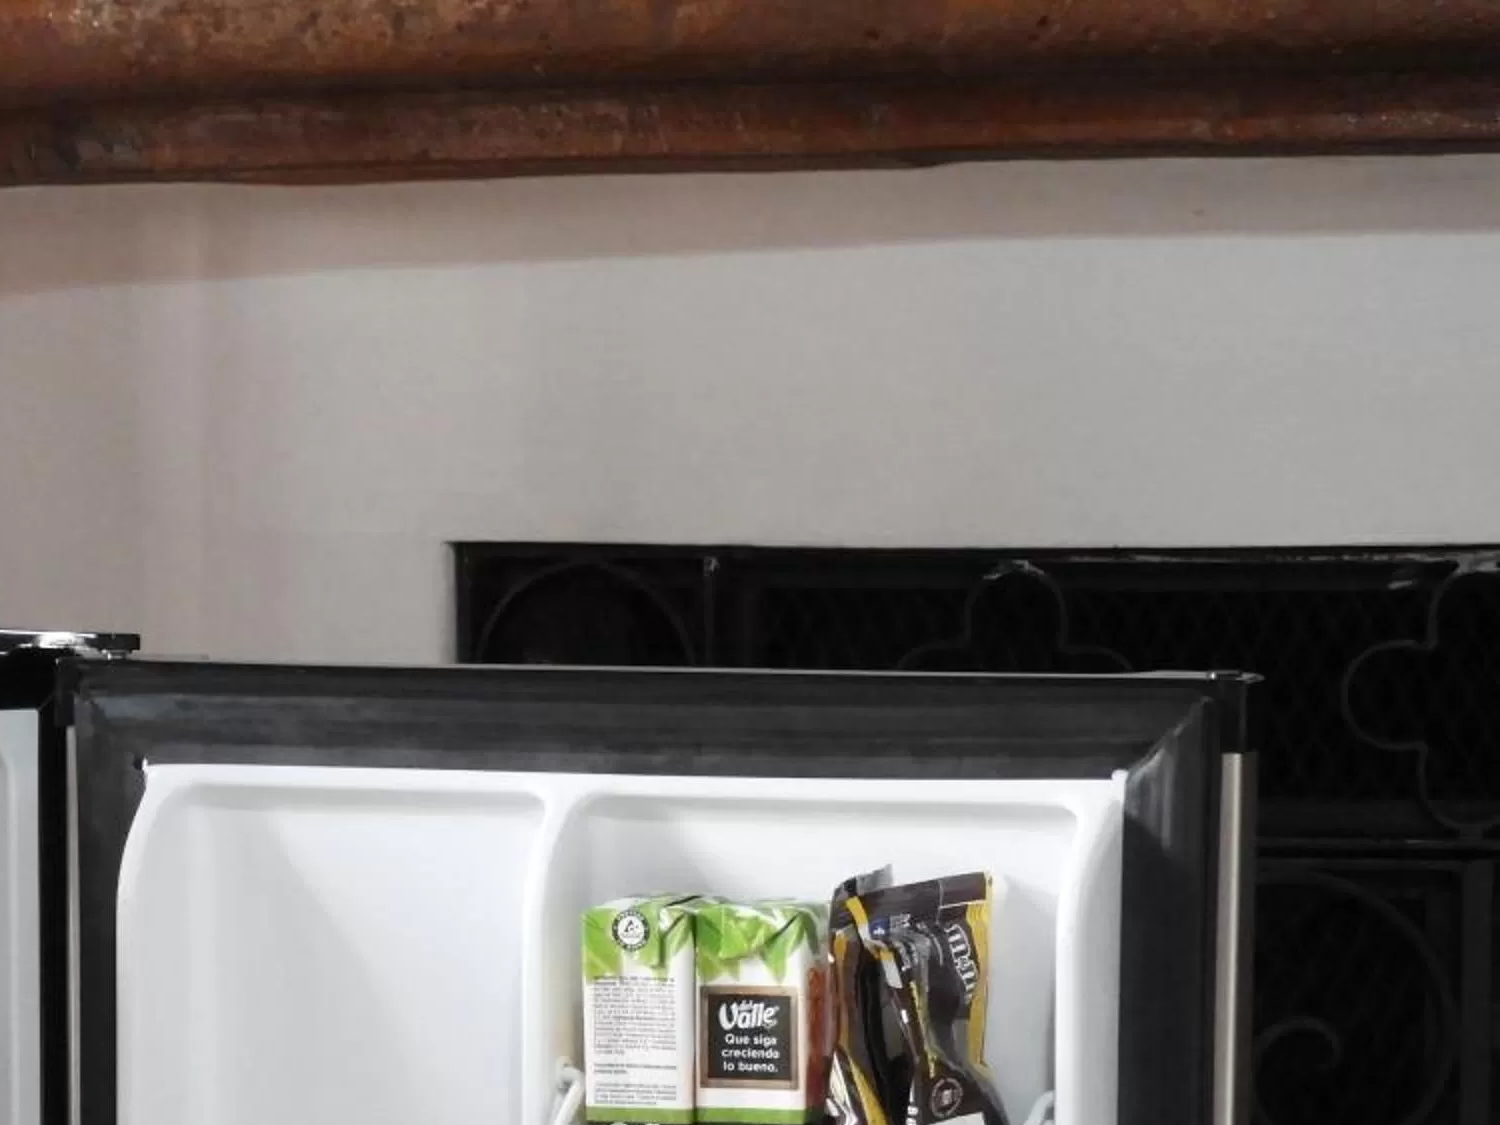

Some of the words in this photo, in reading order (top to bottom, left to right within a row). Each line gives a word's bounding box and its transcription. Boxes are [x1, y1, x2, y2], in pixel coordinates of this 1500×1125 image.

[718, 1001, 778, 1030] Valle
[724, 1033, 750, 1045] Que
[753, 1034, 778, 1048] siga
[721, 1047, 781, 1059] creciendo
[723, 1061, 735, 1071] lo
[737, 1061, 779, 1073] bueno.
